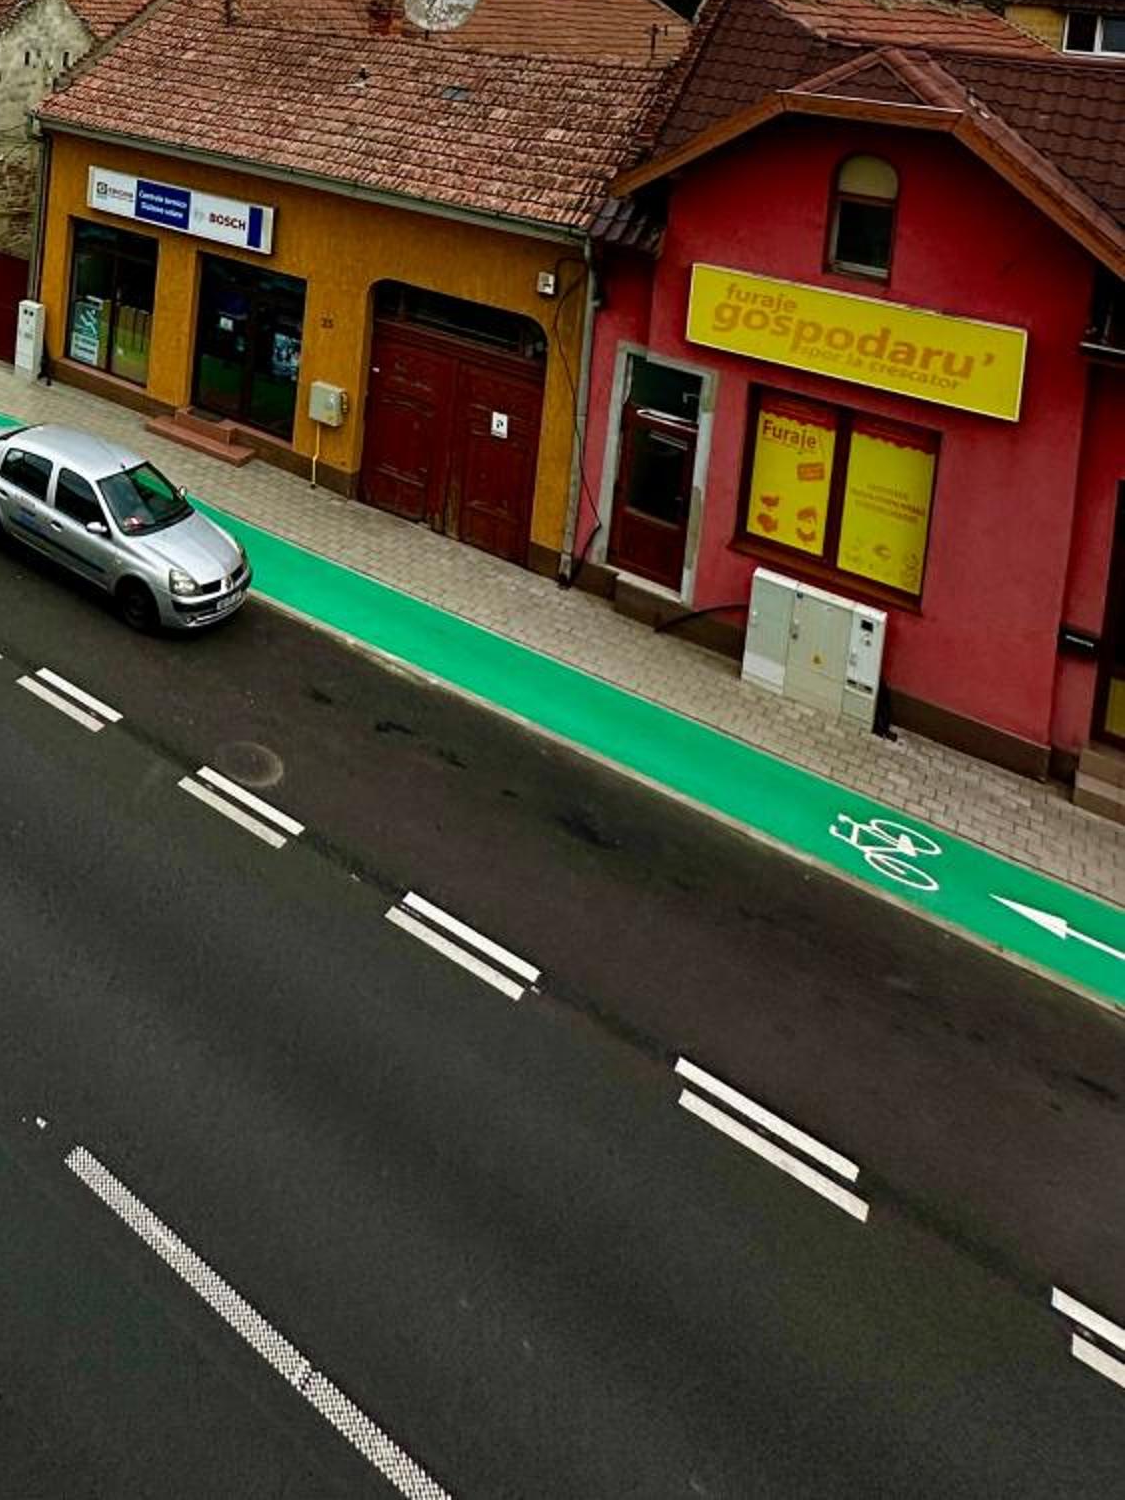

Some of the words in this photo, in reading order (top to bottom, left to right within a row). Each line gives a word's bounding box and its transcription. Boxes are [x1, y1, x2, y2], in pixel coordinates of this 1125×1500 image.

[208, 212, 246, 231] BOSCH
[725, 282, 797, 314] furaje
[762, 419, 818, 451] Furaje
